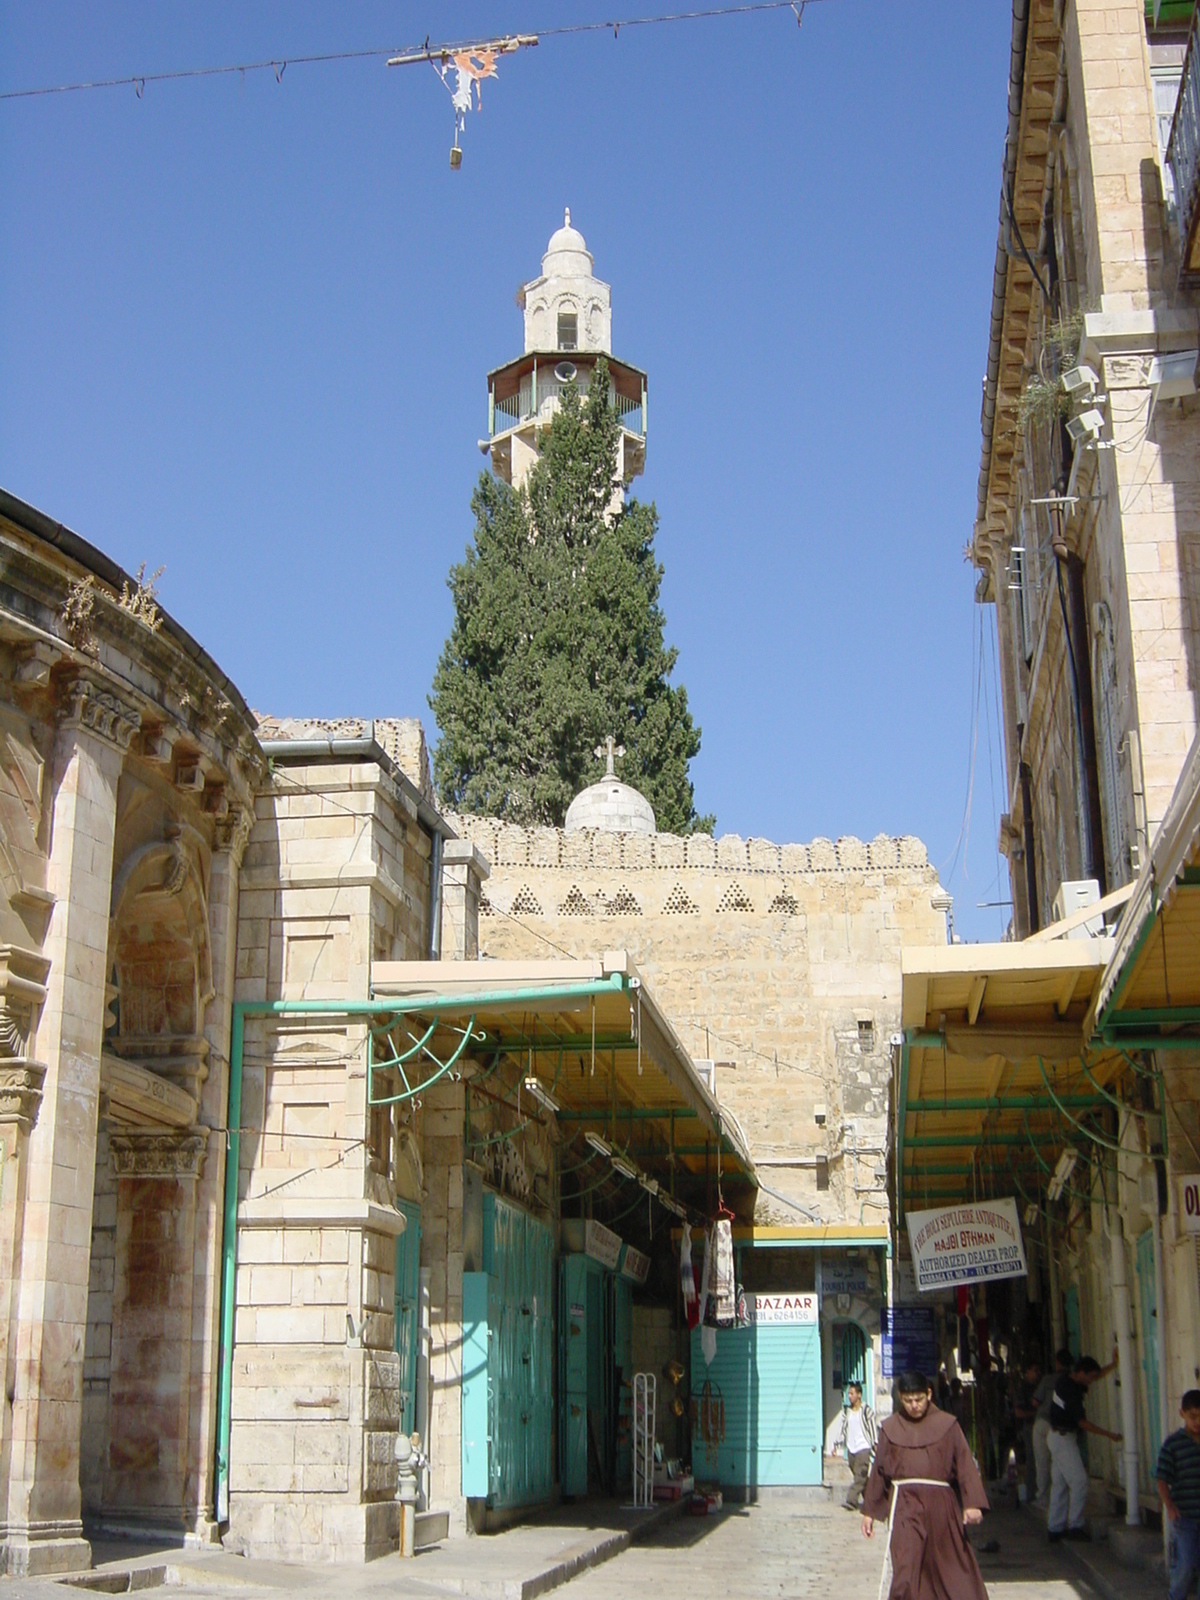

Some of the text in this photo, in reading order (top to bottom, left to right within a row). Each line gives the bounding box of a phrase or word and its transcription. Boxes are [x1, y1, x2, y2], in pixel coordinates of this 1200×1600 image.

[914, 1210, 1016, 1254] THE HOLY SEPULCHRE ANTIQUITIES
[959, 1230, 996, 1249] OTHMAN
[919, 1253, 967, 1273] AUTHORIZED
[968, 1249, 998, 1267] DEALER
[998, 1246, 1019, 1261] PROP
[754, 1297, 812, 1309] BAZAAR
[773, 1309, 808, 1320] 6264156
